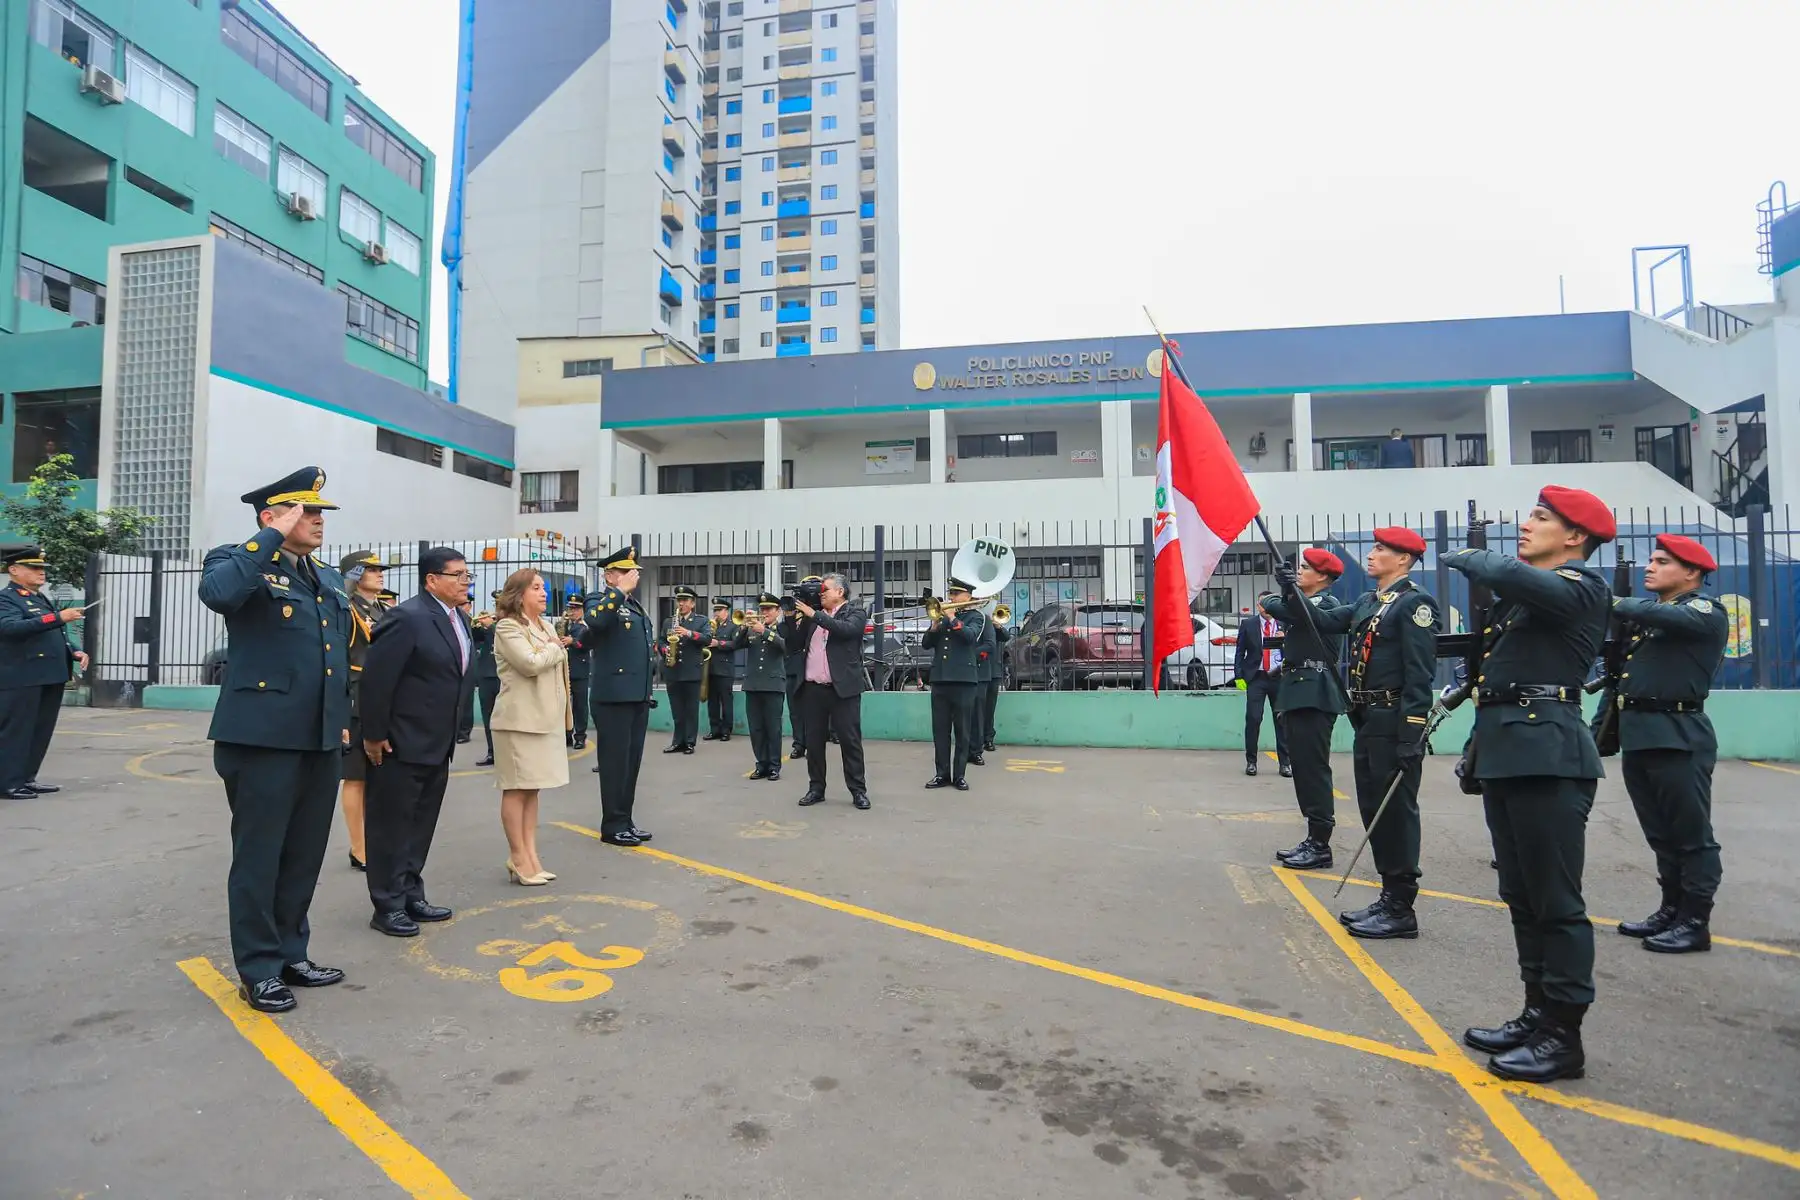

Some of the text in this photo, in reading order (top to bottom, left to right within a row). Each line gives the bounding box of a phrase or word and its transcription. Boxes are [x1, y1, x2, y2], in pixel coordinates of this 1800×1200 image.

[967, 351, 1114, 372] POLICLINICO PNP
[938, 366, 1145, 390] WALTER ROSALES LEON
[974, 539, 1009, 559] PNP
[498, 940, 645, 1003] 29
